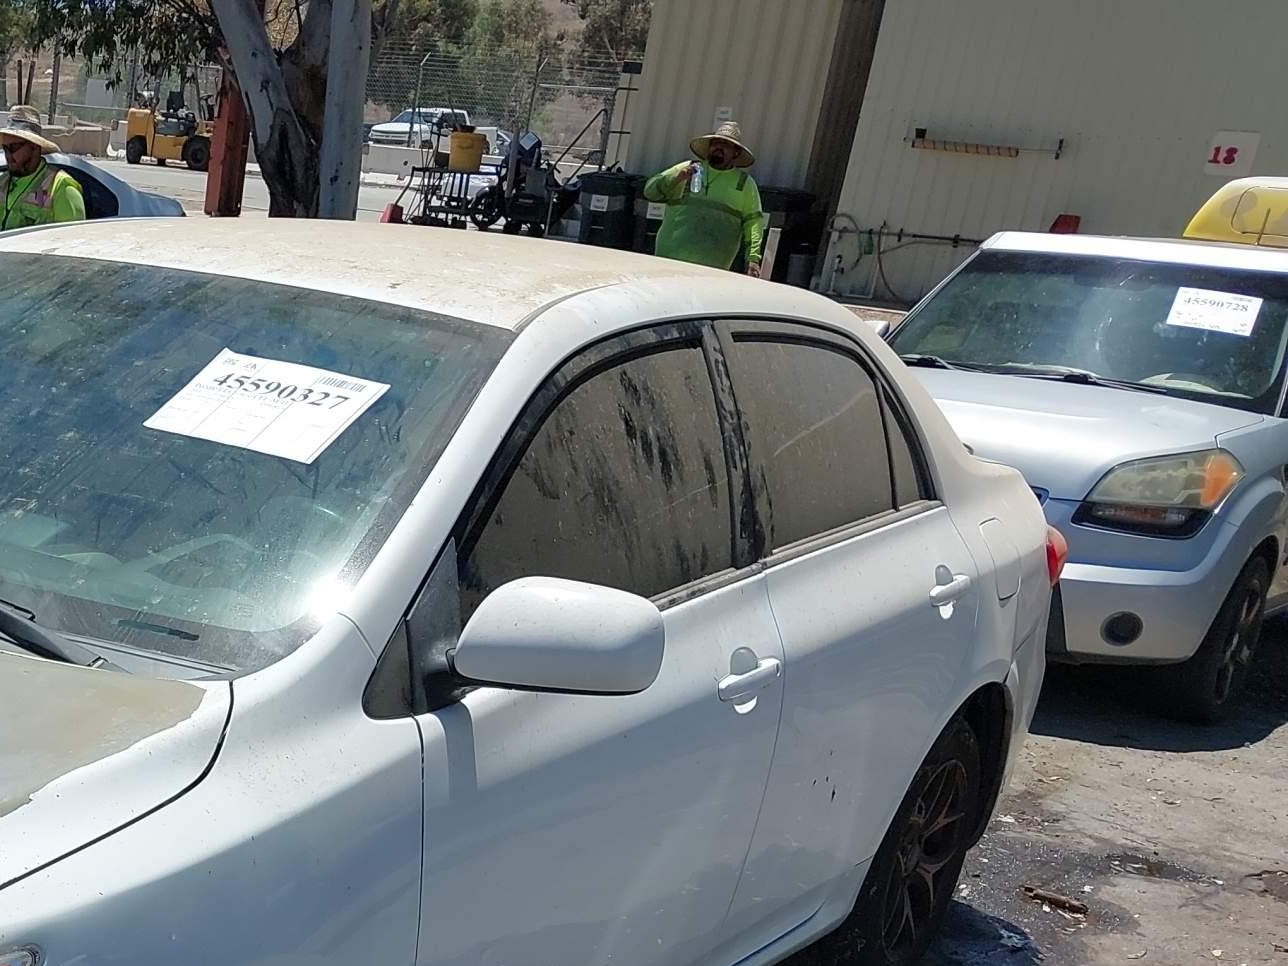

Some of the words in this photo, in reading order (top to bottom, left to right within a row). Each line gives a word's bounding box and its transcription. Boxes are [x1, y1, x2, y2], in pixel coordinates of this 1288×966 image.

[1207, 145, 1239, 165] 18
[1183, 296, 1250, 313] 45590728
[213, 372, 350, 410] 45590327
